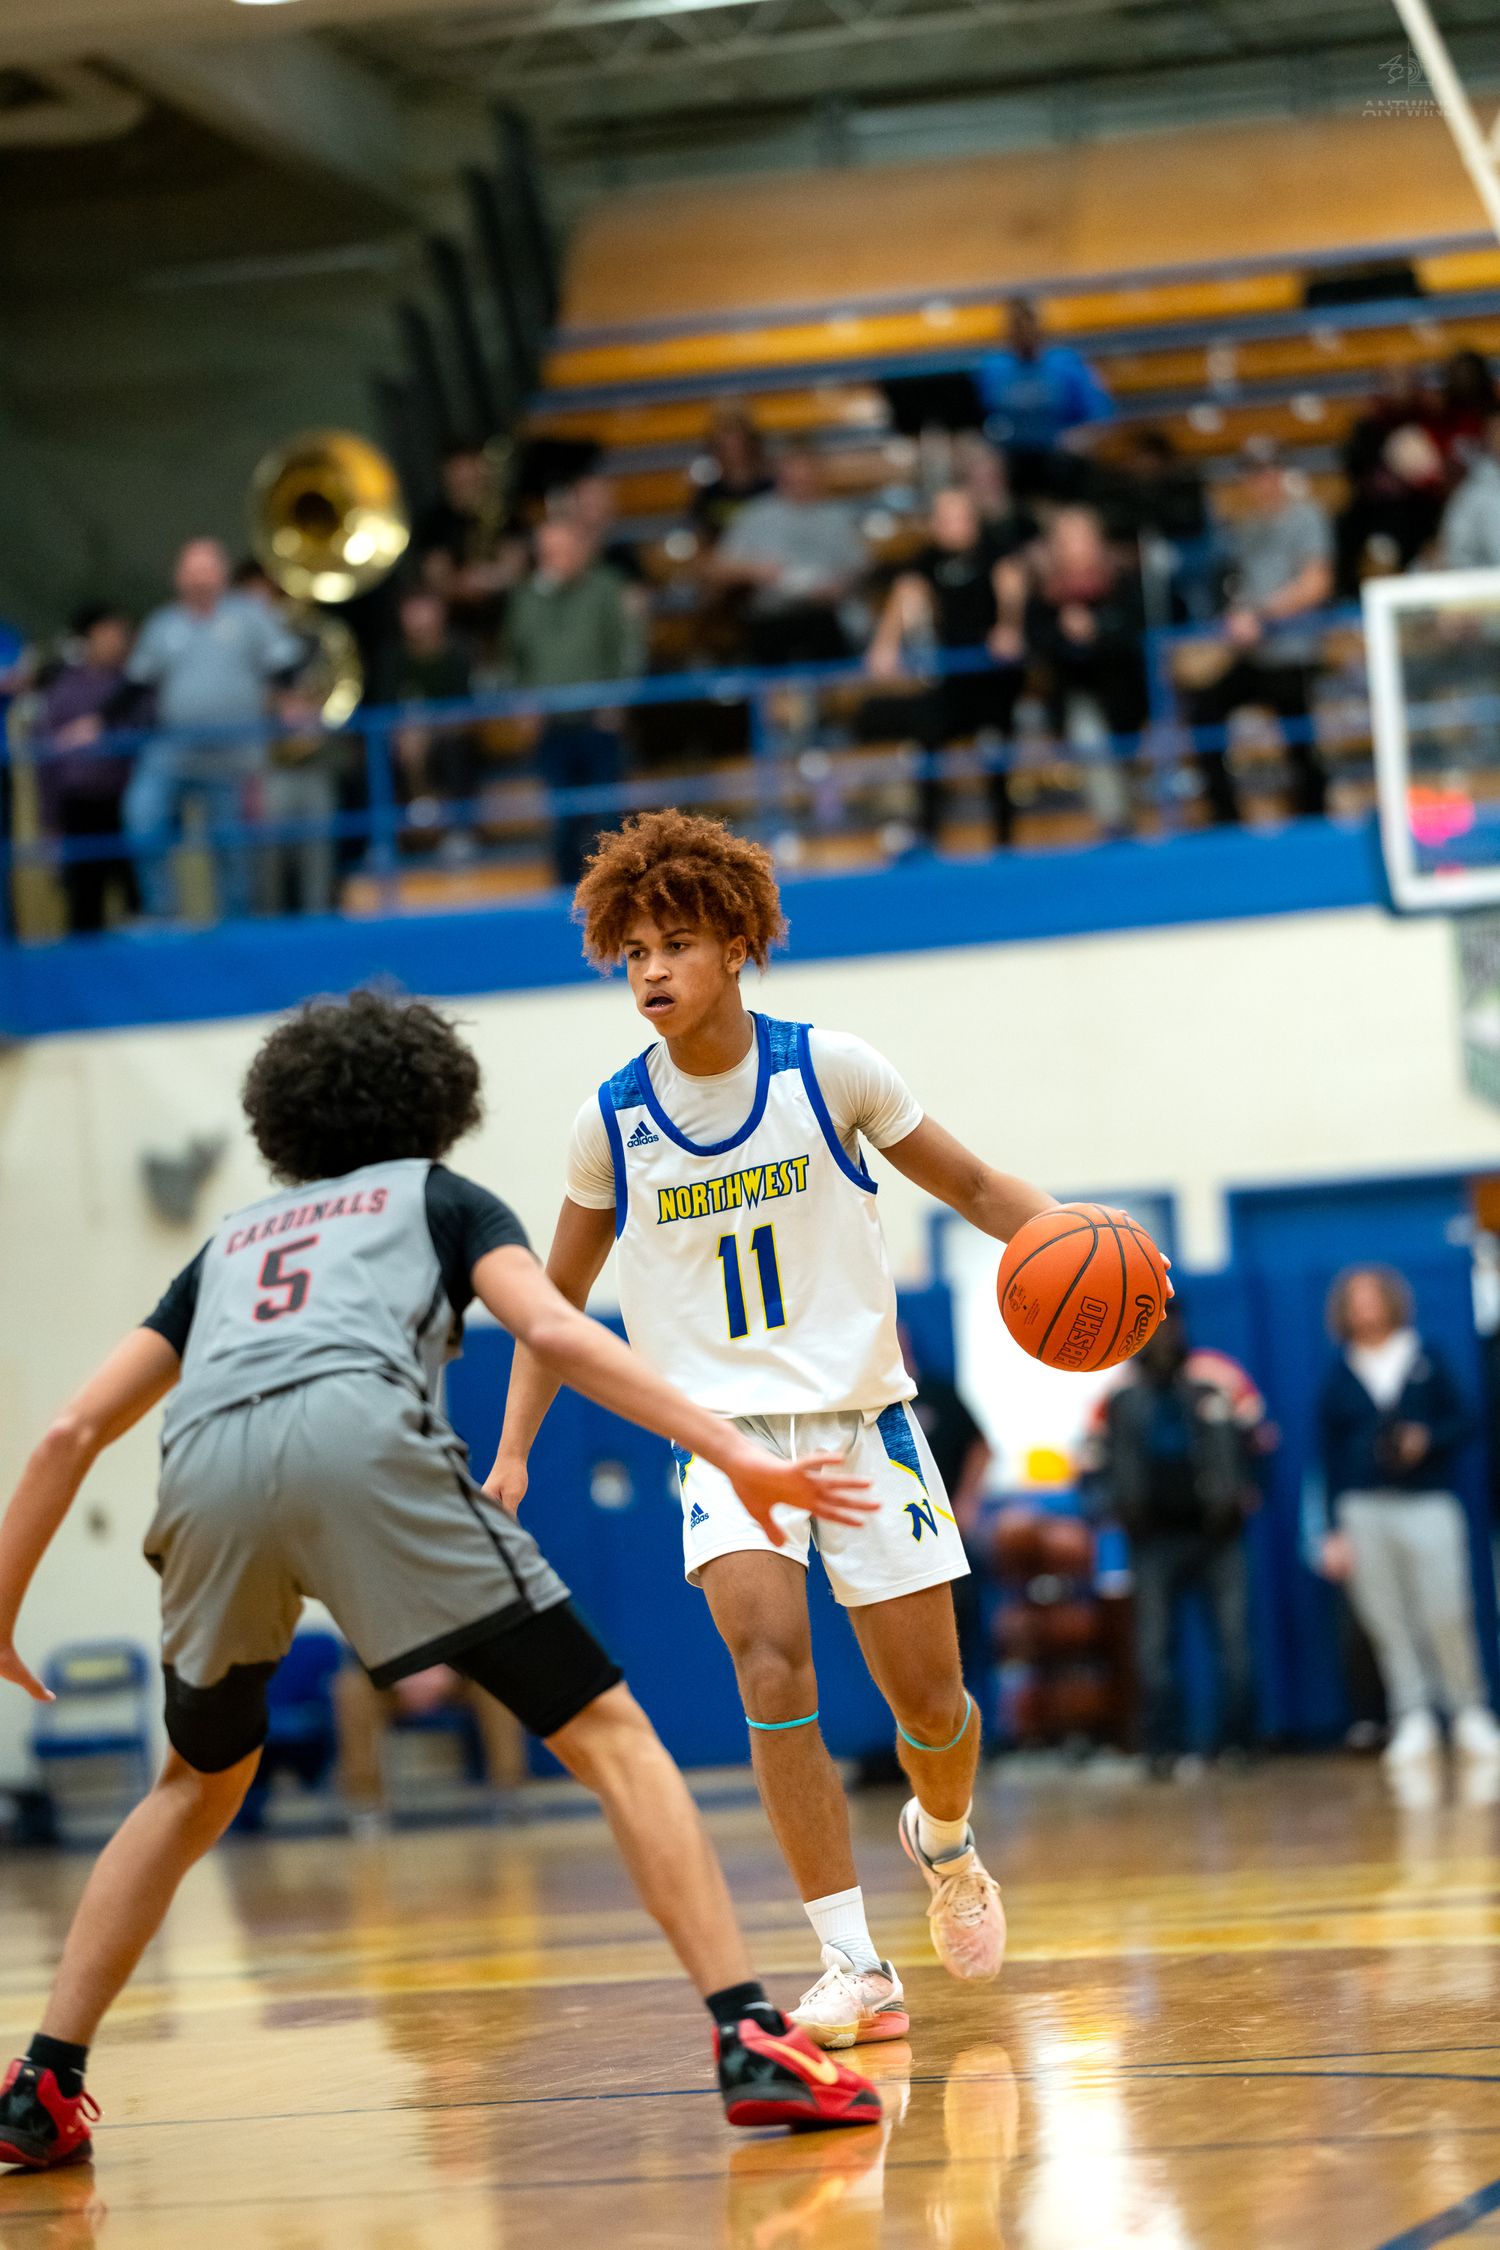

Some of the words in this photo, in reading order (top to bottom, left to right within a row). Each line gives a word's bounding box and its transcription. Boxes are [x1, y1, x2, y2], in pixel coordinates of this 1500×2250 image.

[626, 1134, 660, 1148] adidas
[224, 1187, 388, 1256] CARDINALS
[657, 1154, 809, 1225] NORTHWEST
[252, 1233, 321, 1323] 5
[716, 1222, 788, 1341] 11
[691, 1512, 710, 1530] didas
[902, 1498, 938, 1543] N
